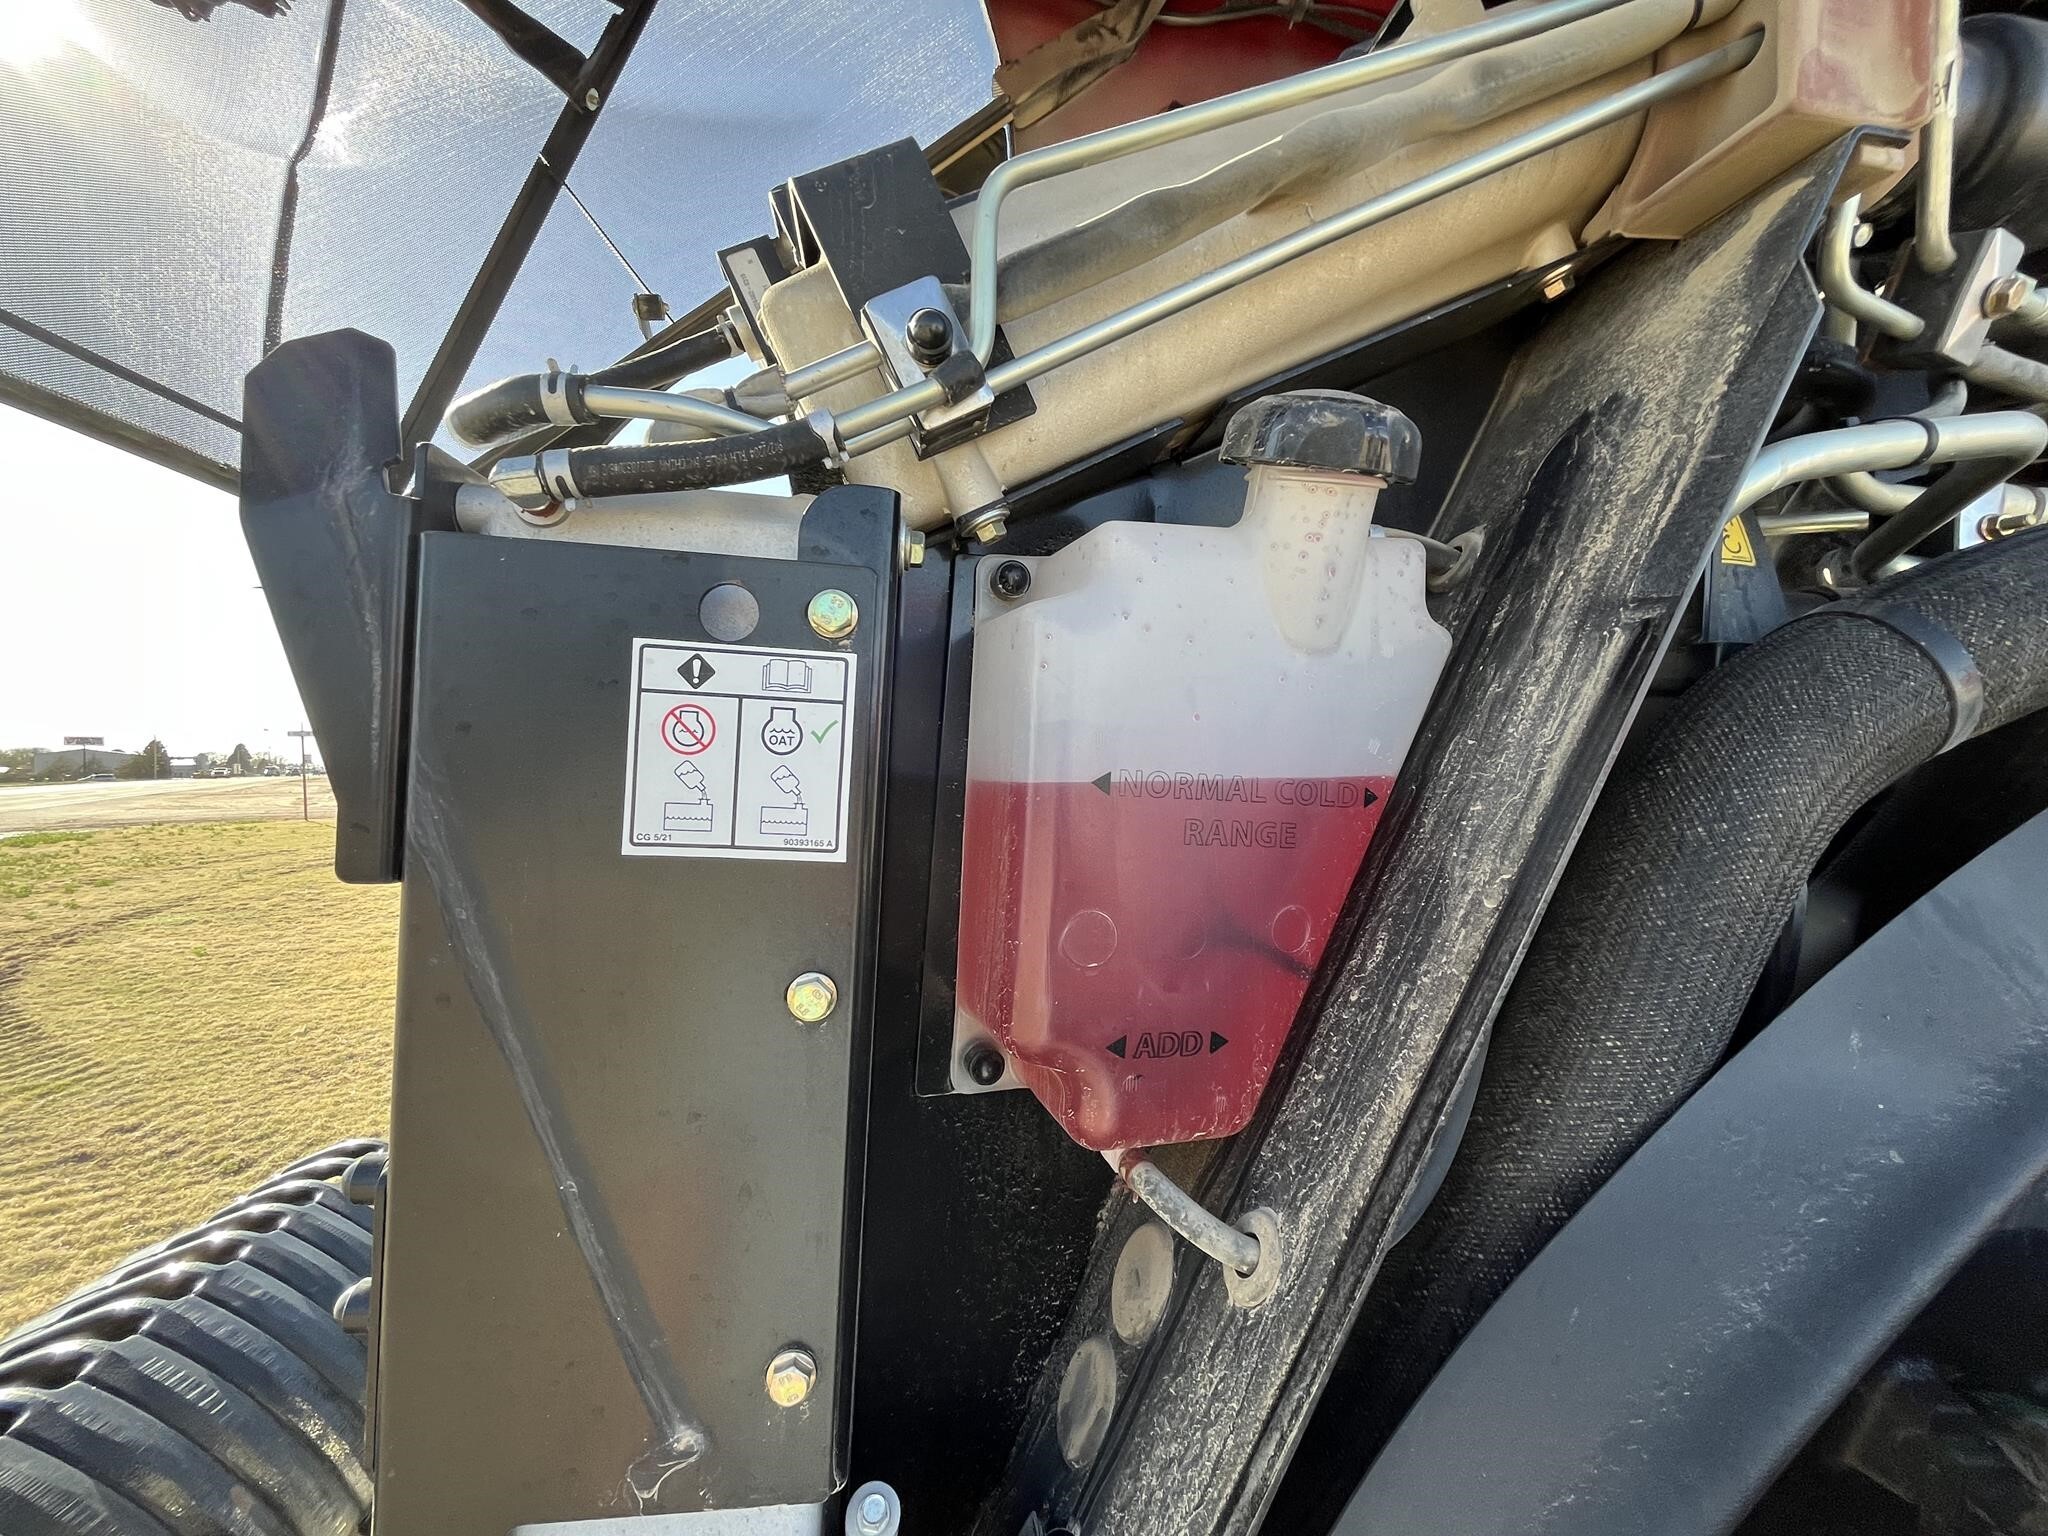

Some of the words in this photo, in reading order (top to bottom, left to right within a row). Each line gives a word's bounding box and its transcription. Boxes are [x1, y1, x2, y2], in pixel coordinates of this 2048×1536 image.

[769, 735, 795, 747] OAT
[1118, 768, 1267, 803] NORMAL
[1274, 777, 1359, 809] COLD
[636, 833, 651, 841] CG
[653, 833, 672, 841] 5/21
[783, 838, 826, 848] 90393165
[826, 839, 833, 847] A
[1183, 817, 1297, 849] RANGE
[1132, 1030, 1204, 1059] ADD
